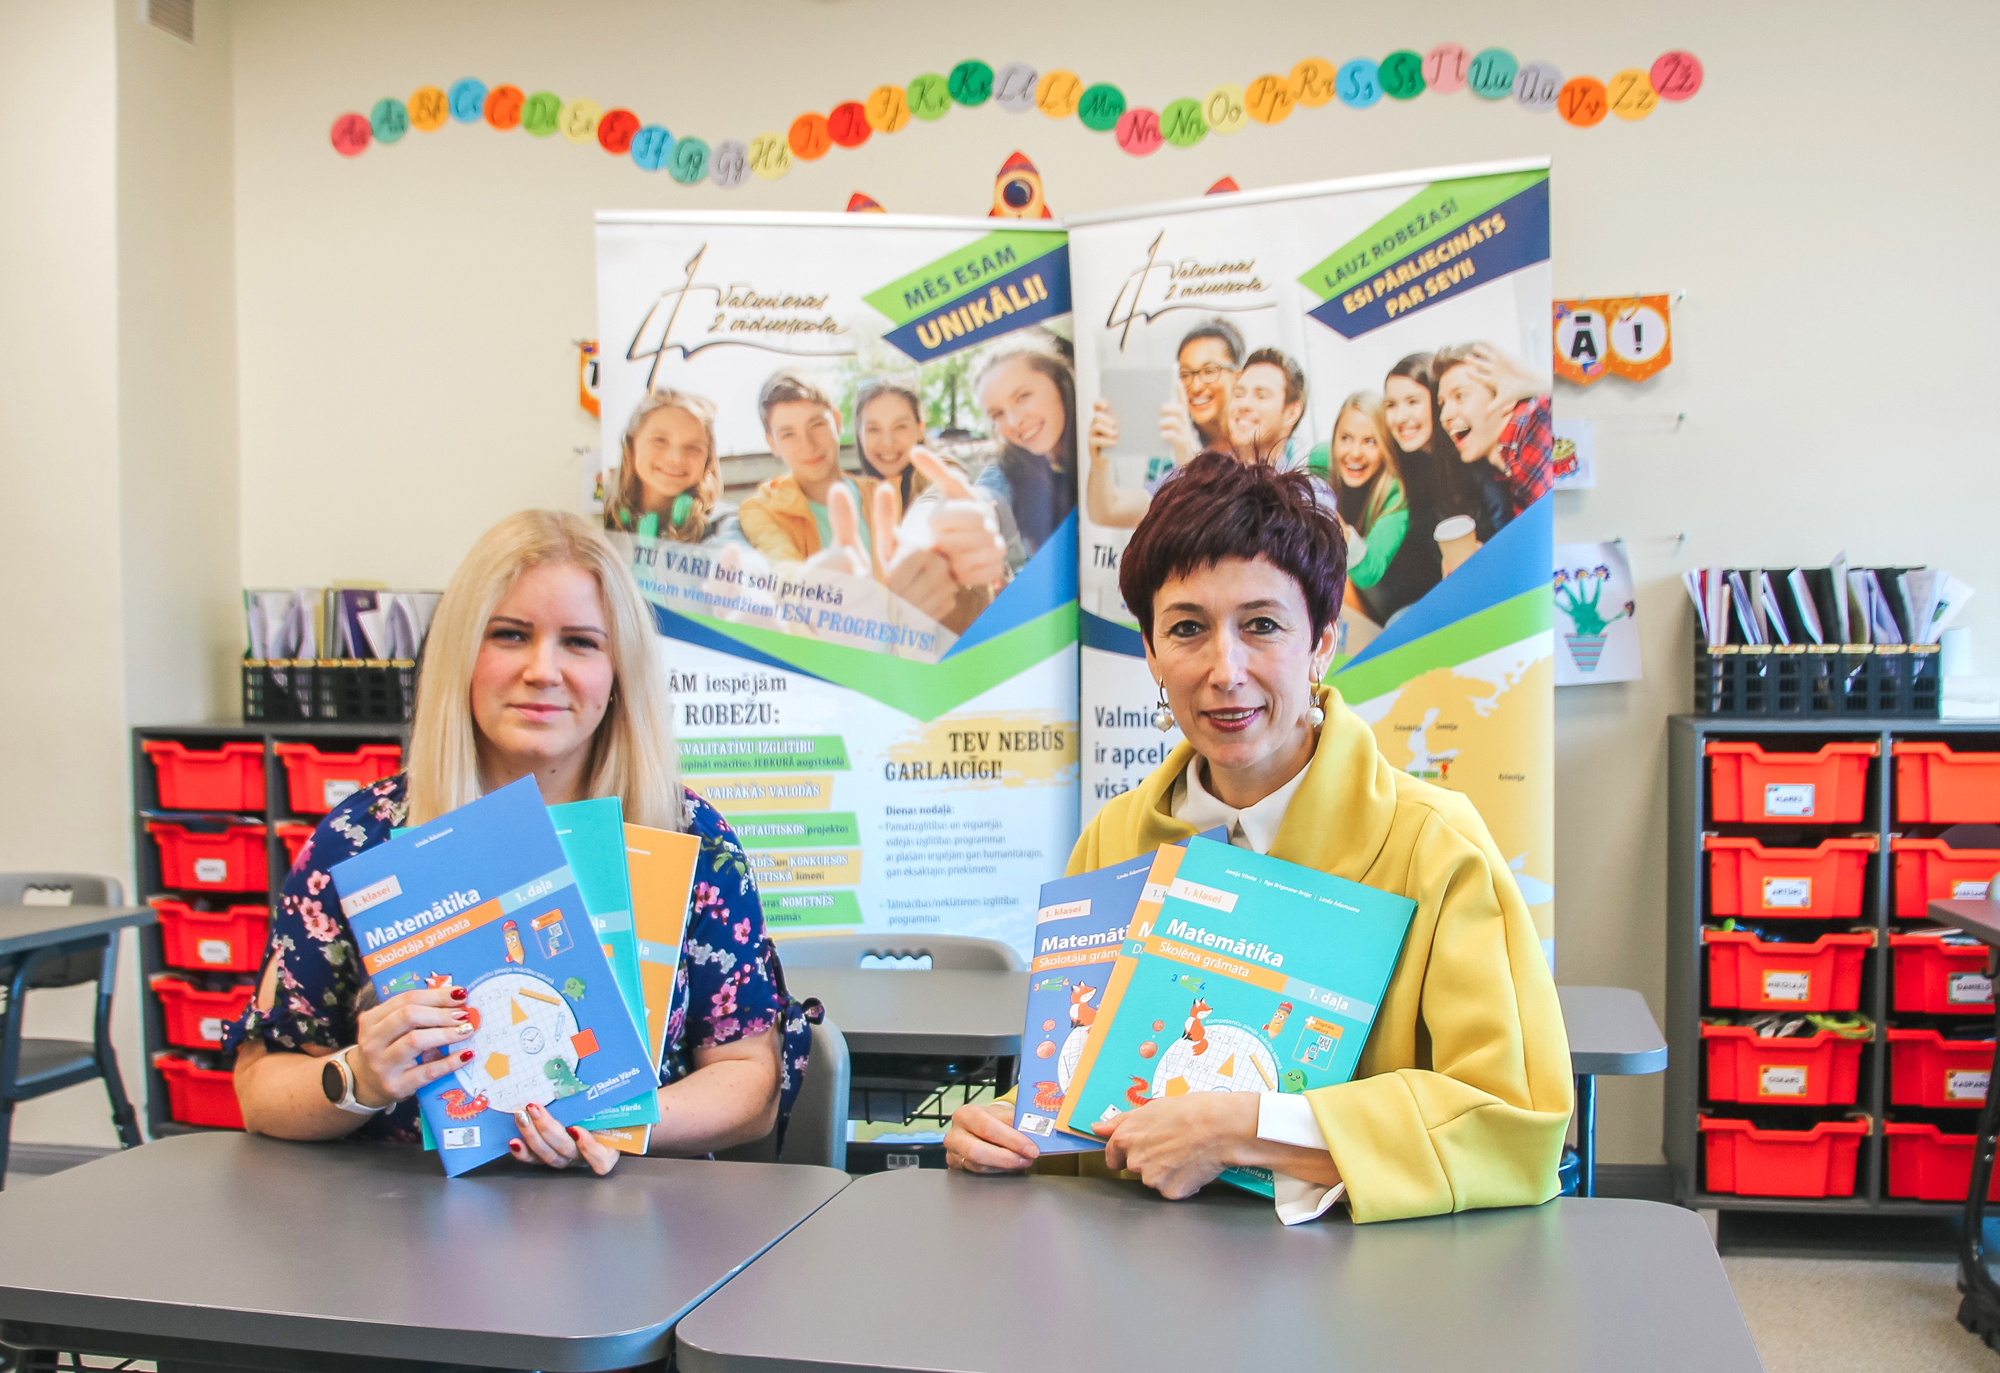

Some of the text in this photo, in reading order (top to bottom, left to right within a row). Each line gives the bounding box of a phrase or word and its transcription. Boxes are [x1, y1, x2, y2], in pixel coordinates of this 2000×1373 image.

[1324, 197, 1459, 289] LAUZ ROBEŽAS!
[1342, 212, 1507, 315] ESI PĀRLIECINĀTS
[904, 246, 1017, 310] MĒS ESAM
[716, 285, 830, 310] Valmieras
[1384, 284, 1427, 319] PAR
[915, 273, 1049, 350] UNIKĀLI!
[1094, 545, 1118, 570] Tik
[633, 546, 659, 567] TU
[666, 551, 712, 577] VARI
[749, 571, 778, 592] soli
[781, 580, 844, 606] priekšā
[637, 577, 679, 598] aviem
[781, 602, 813, 626] ESI
[668, 670, 788, 696] ĀM iespējām
[684, 698, 781, 727] ROBEŽU:
[757, 736, 815, 754] IZGLĪTĪBU
[948, 724, 1066, 753] TEV NEBŪS
[884, 755, 1003, 782] GARLAICĪGI!
[1095, 743, 1172, 769] ir apcel
[705, 780, 822, 800] VAIRĀKĀS VALODĀS
[886, 805, 918, 816] Dienas
[733, 822, 805, 837] ARPTAUTISKOS
[789, 853, 849, 868] KONKURSOS
[527, 879, 554, 898] daļa
[757, 868, 793, 883] UTISKĀ
[362, 885, 392, 903] klasei
[781, 891, 835, 908] NOMETNĒS
[1192, 887, 1223, 904] klasei
[365, 888, 482, 950] Matemātika
[1054, 905, 1082, 917] klasei
[373, 918, 471, 968] Skolotāja grāmata
[1041, 925, 1130, 953] Matemāti
[1165, 917, 1285, 969] Matemātika
[1039, 952, 1087, 968] Skolotāja
[1158, 941, 1202, 963] Skolēna
[1202, 955, 1250, 978] grāmata
[1308, 988, 1349, 1011] 1. daļa
[596, 1075, 621, 1091] Skolas
